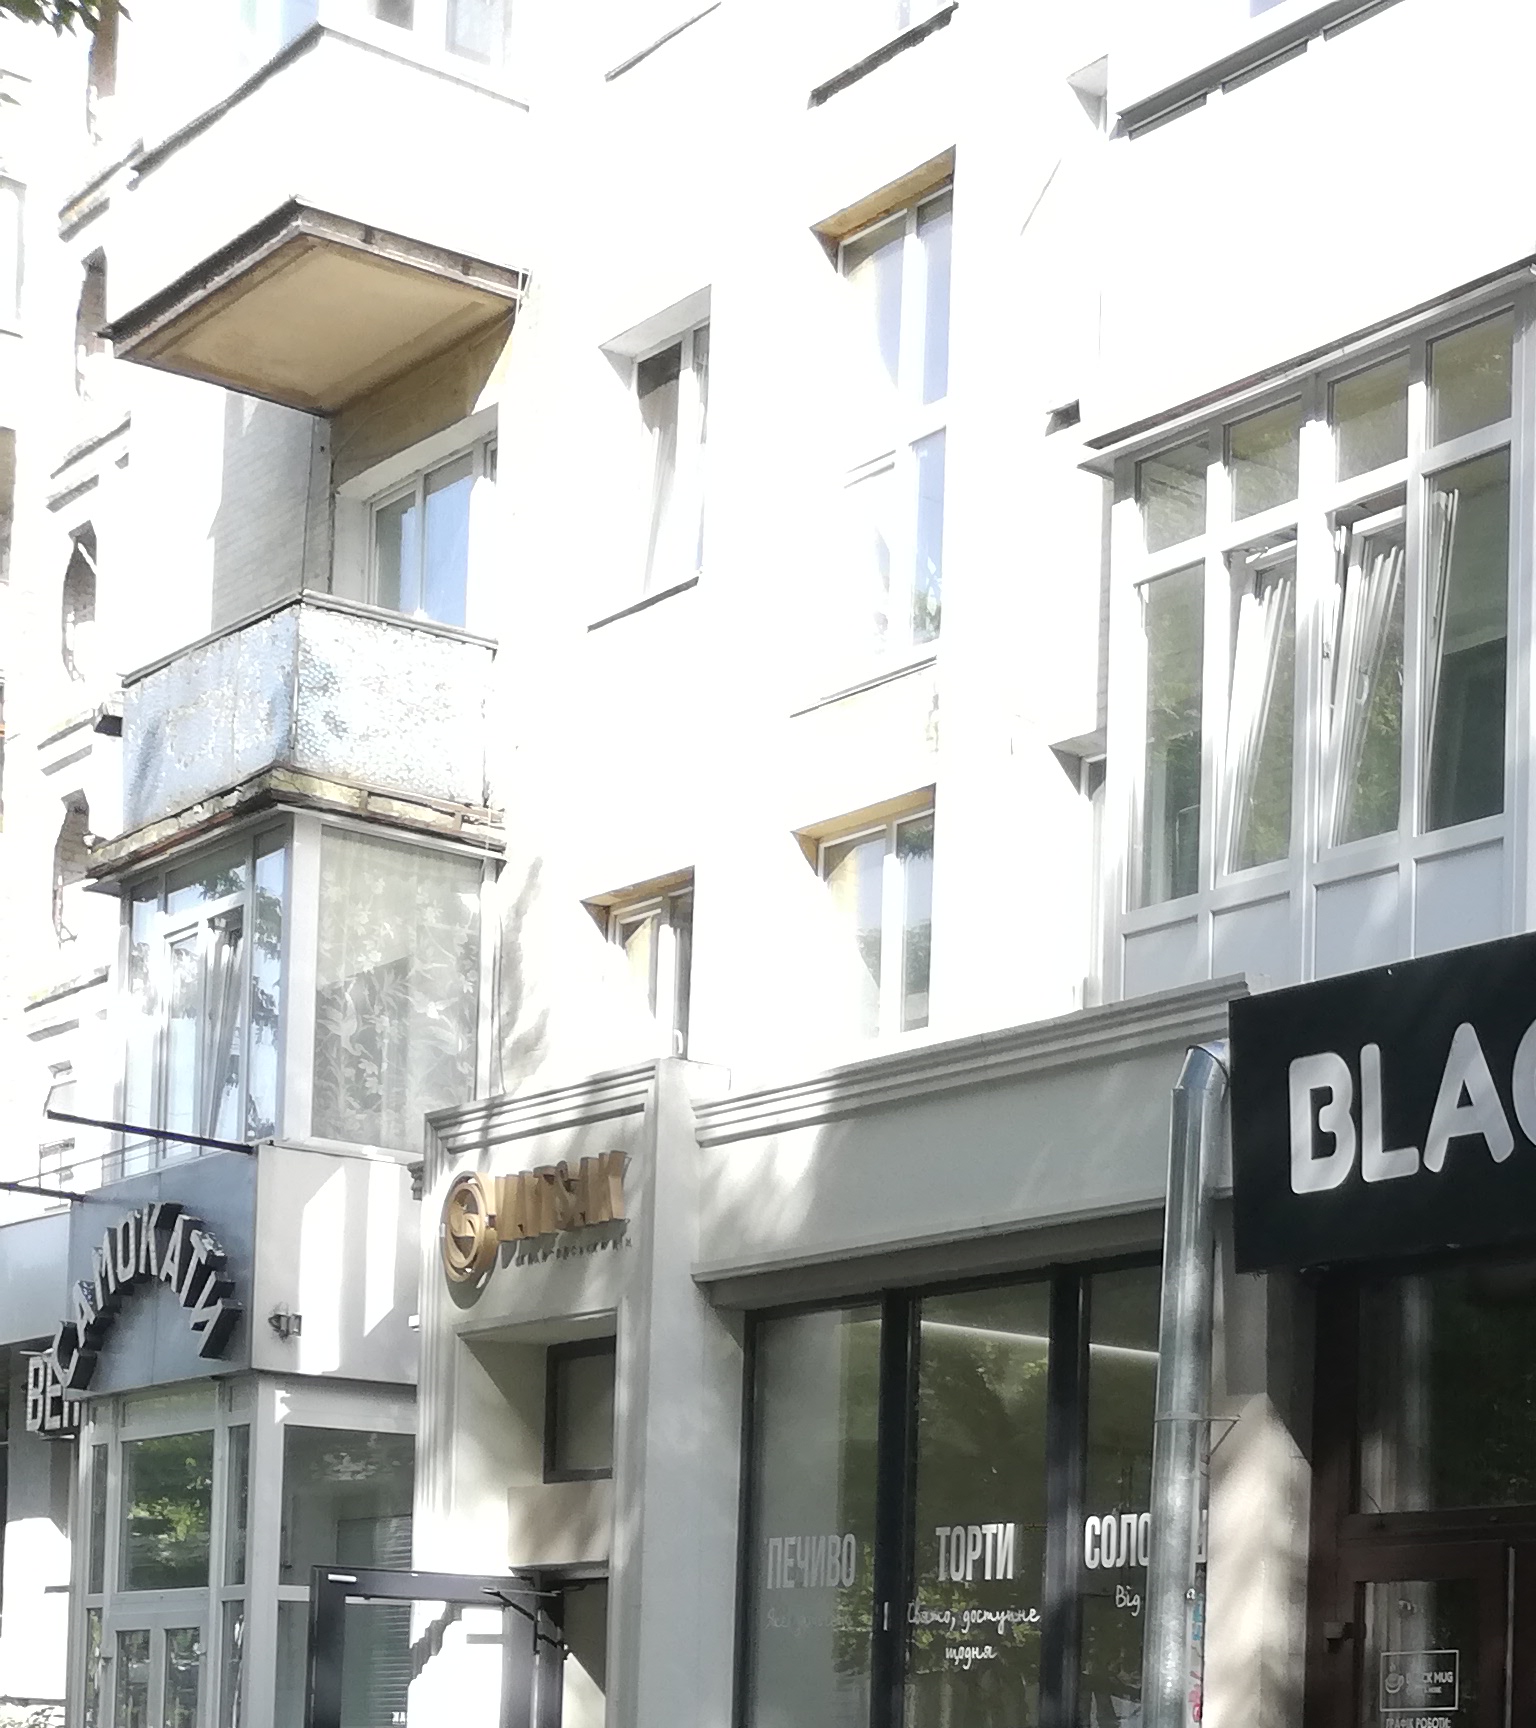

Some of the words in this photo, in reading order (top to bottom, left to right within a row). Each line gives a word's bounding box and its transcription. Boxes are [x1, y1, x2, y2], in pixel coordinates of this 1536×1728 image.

[51, 1202, 240, 1388] САМОКАТИ
[26, 1356, 80, 1432] ВЕ
[766, 1533, 856, 1589] ПЕЧИВО
[935, 1522, 1016, 1583] ТОРТИ
[1433, 1671, 1454, 1684] MUG
